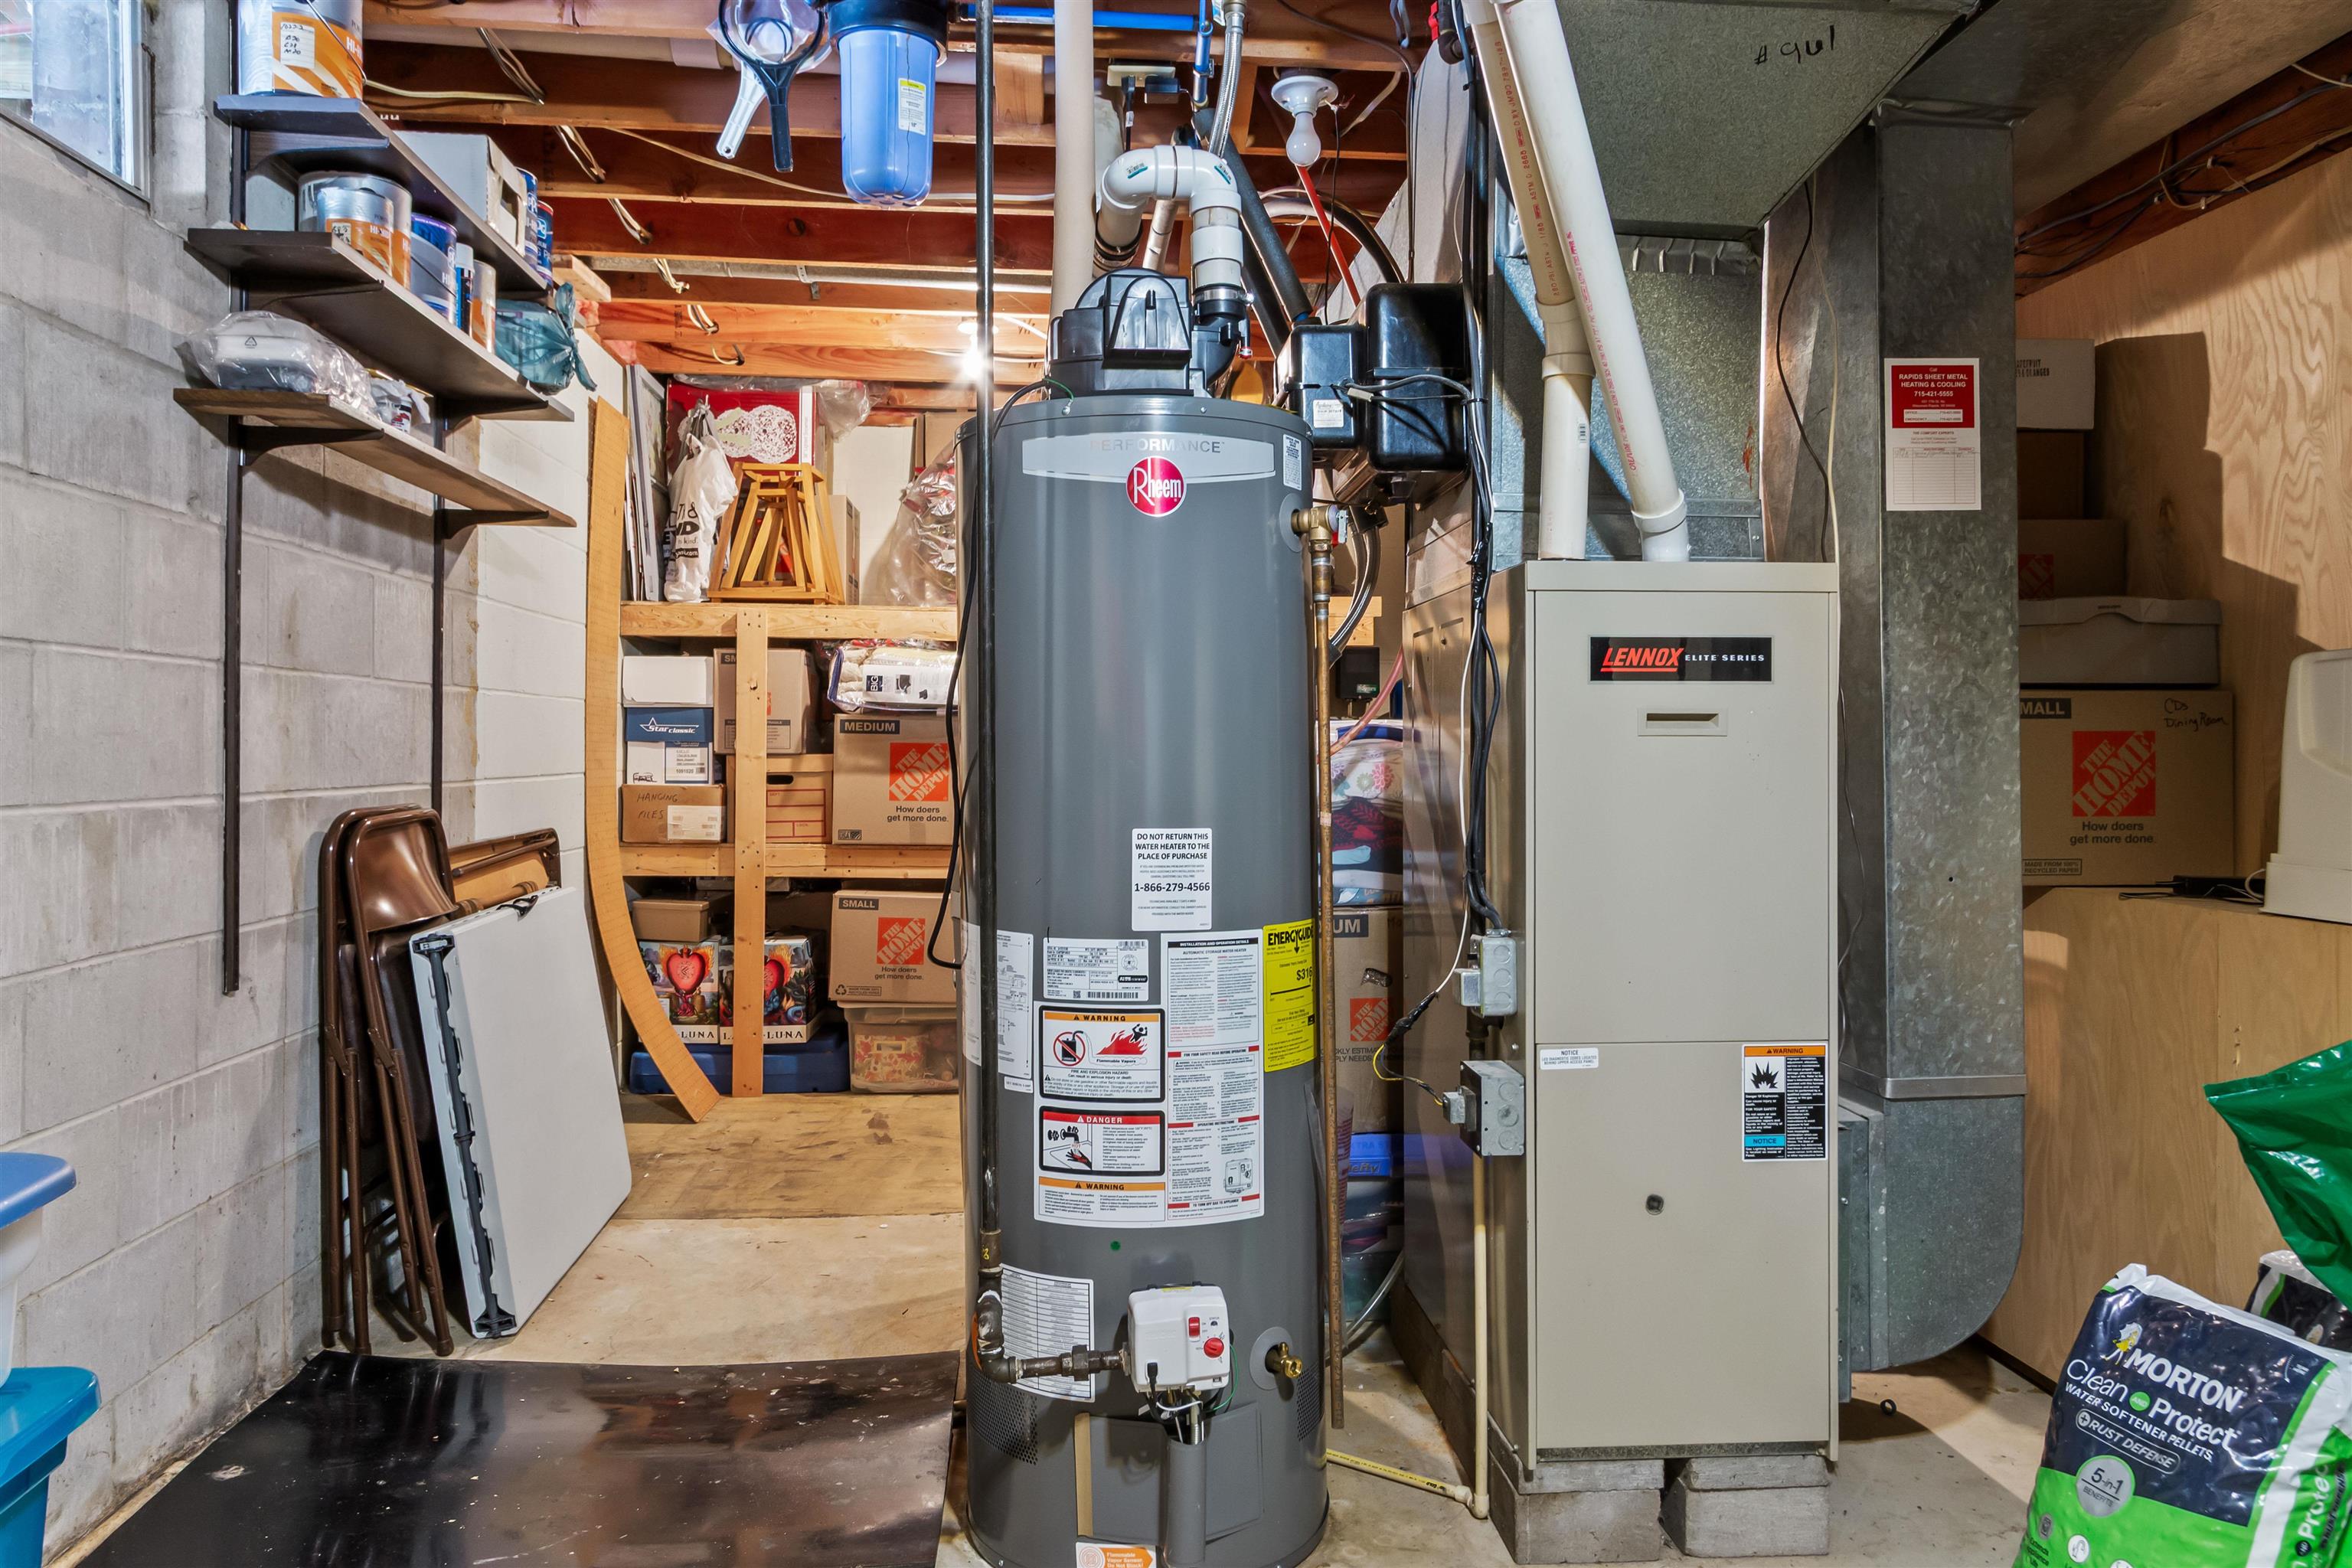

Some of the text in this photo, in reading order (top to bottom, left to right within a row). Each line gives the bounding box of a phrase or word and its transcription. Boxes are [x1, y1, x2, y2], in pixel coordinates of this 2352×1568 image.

[1134, 457, 1182, 506] Rheem
[1602, 647, 1684, 667] LENNOX
[871, 675, 879, 691] BIG
[2020, 701, 2065, 715] MALL
[648, 724, 670, 733] Star
[844, 721, 896, 732] MEDIUM
[895, 748, 921, 773] THE
[2081, 739, 2116, 773] THE
[889, 743, 949, 801] HOME
[2073, 731, 2156, 818] HOME
[912, 766, 950, 802] DEPOT
[2105, 763, 2156, 816] DEPOT
[637, 792, 678, 803] HANGING
[638, 810, 665, 820] FILES
[887, 814, 900, 822] get
[926, 813, 949, 822] done.
[896, 805, 940, 814] How doers
[2082, 822, 2144, 831] How doers
[2069, 835, 2089, 846] get
[2092, 835, 2121, 844] more
[1135, 882, 1210, 892] 1-866-279-4566
[842, 899, 875, 909] SMALL
[877, 918, 926, 965] HOME
[882, 922, 902, 942] THE
[895, 935, 926, 965] DEPOT
[2122, 1348, 2244, 1413] MORTON
[2065, 1382, 2102, 1407] WATER
[2101, 1401, 2167, 1441] SOFTENER
[2066, 1358, 2239, 1452] Clean AND Protect
[2088, 1419, 2177, 1468] RUST DEFENSE
[2091, 1467, 2125, 1495] 5-in-1
[2082, 1485, 2115, 1508] BENEFITS
